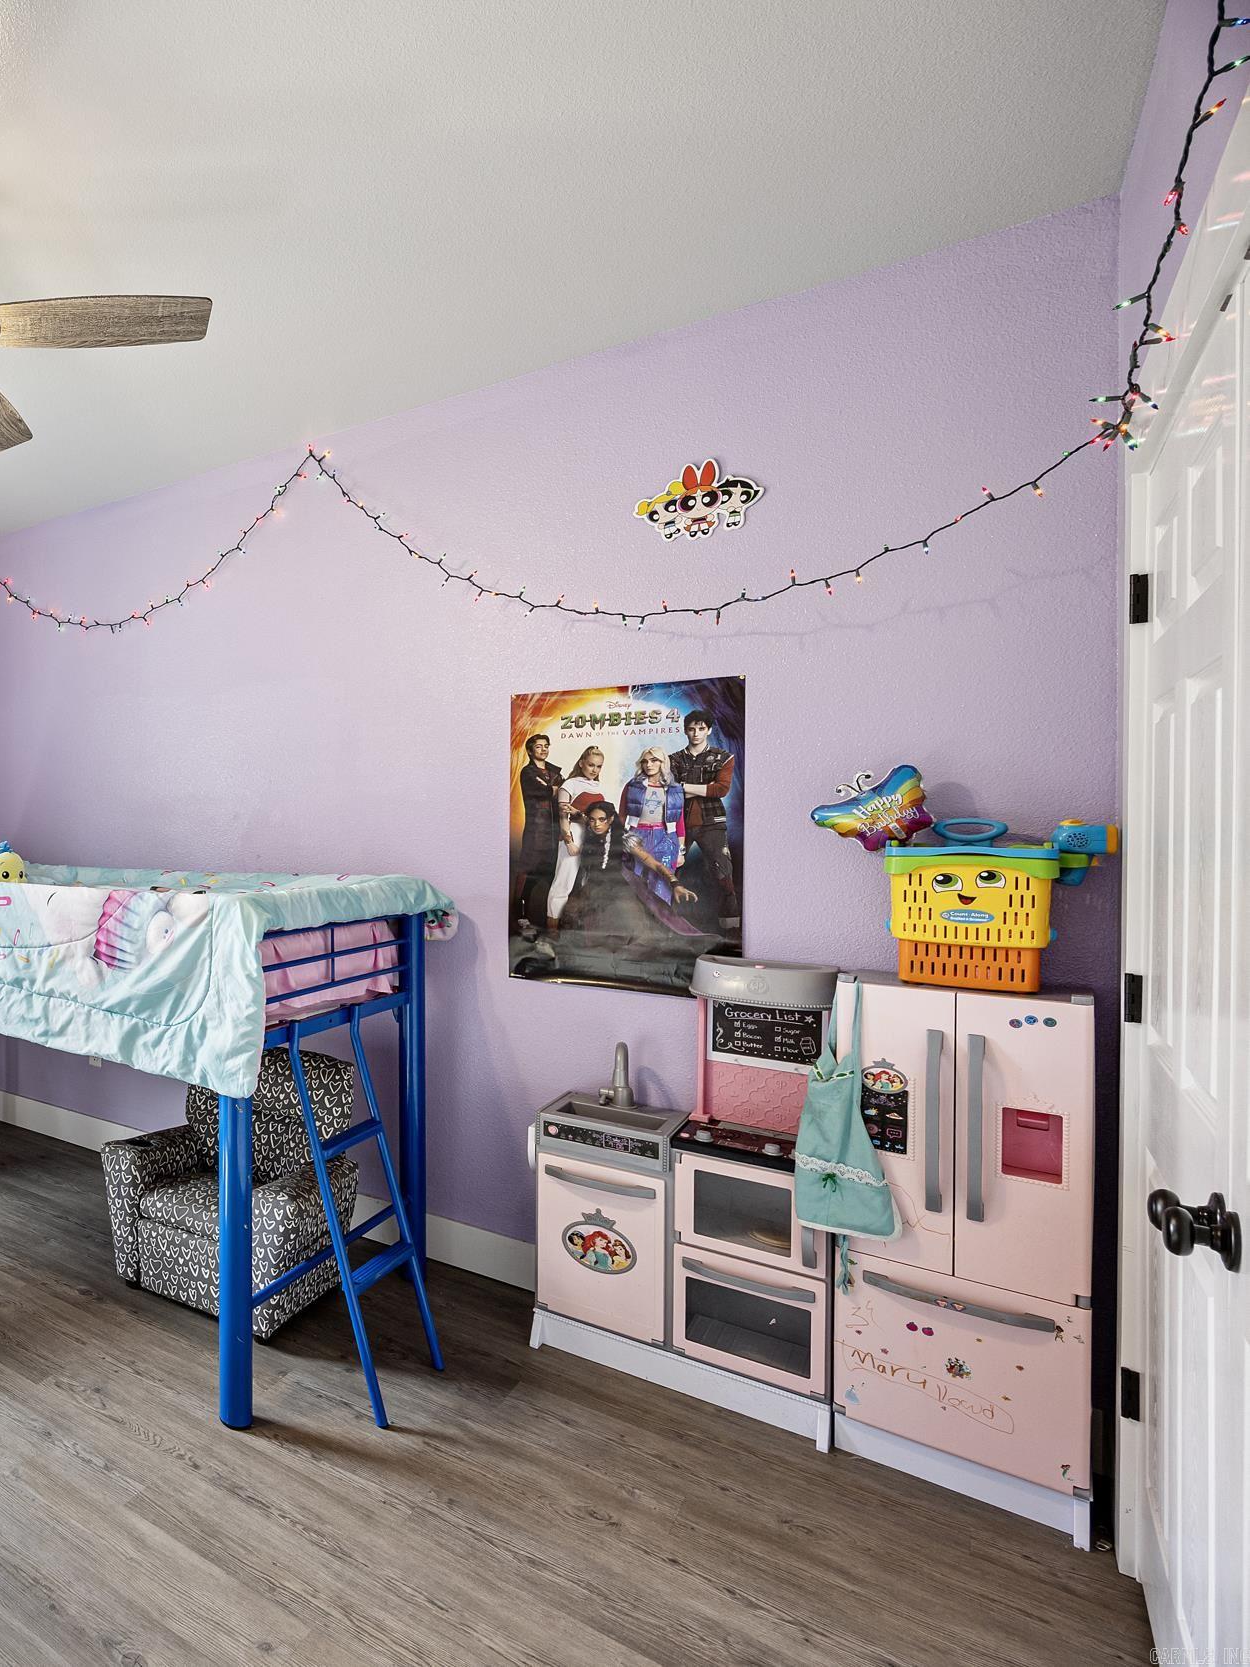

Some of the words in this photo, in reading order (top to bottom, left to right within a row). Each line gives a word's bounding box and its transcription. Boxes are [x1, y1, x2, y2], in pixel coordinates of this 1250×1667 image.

[606, 701, 632, 710] Disney
[560, 710, 662, 731] ZOMBIES
[666, 707, 680, 723] 4
[623, 727, 680, 736] VAMPIRES
[852, 793, 903, 819] Happy
[857, 807, 920, 837] Birthday
[724, 1007, 772, 1021] Grocery
[775, 1010, 801, 1021] List
[742, 1022, 758, 1030] Eggs
[742, 1031, 762, 1040] Bacon
[782, 1027, 801, 1035] Sugar
[742, 1041, 764, 1049] Butter
[782, 1046, 799, 1054] Flour
